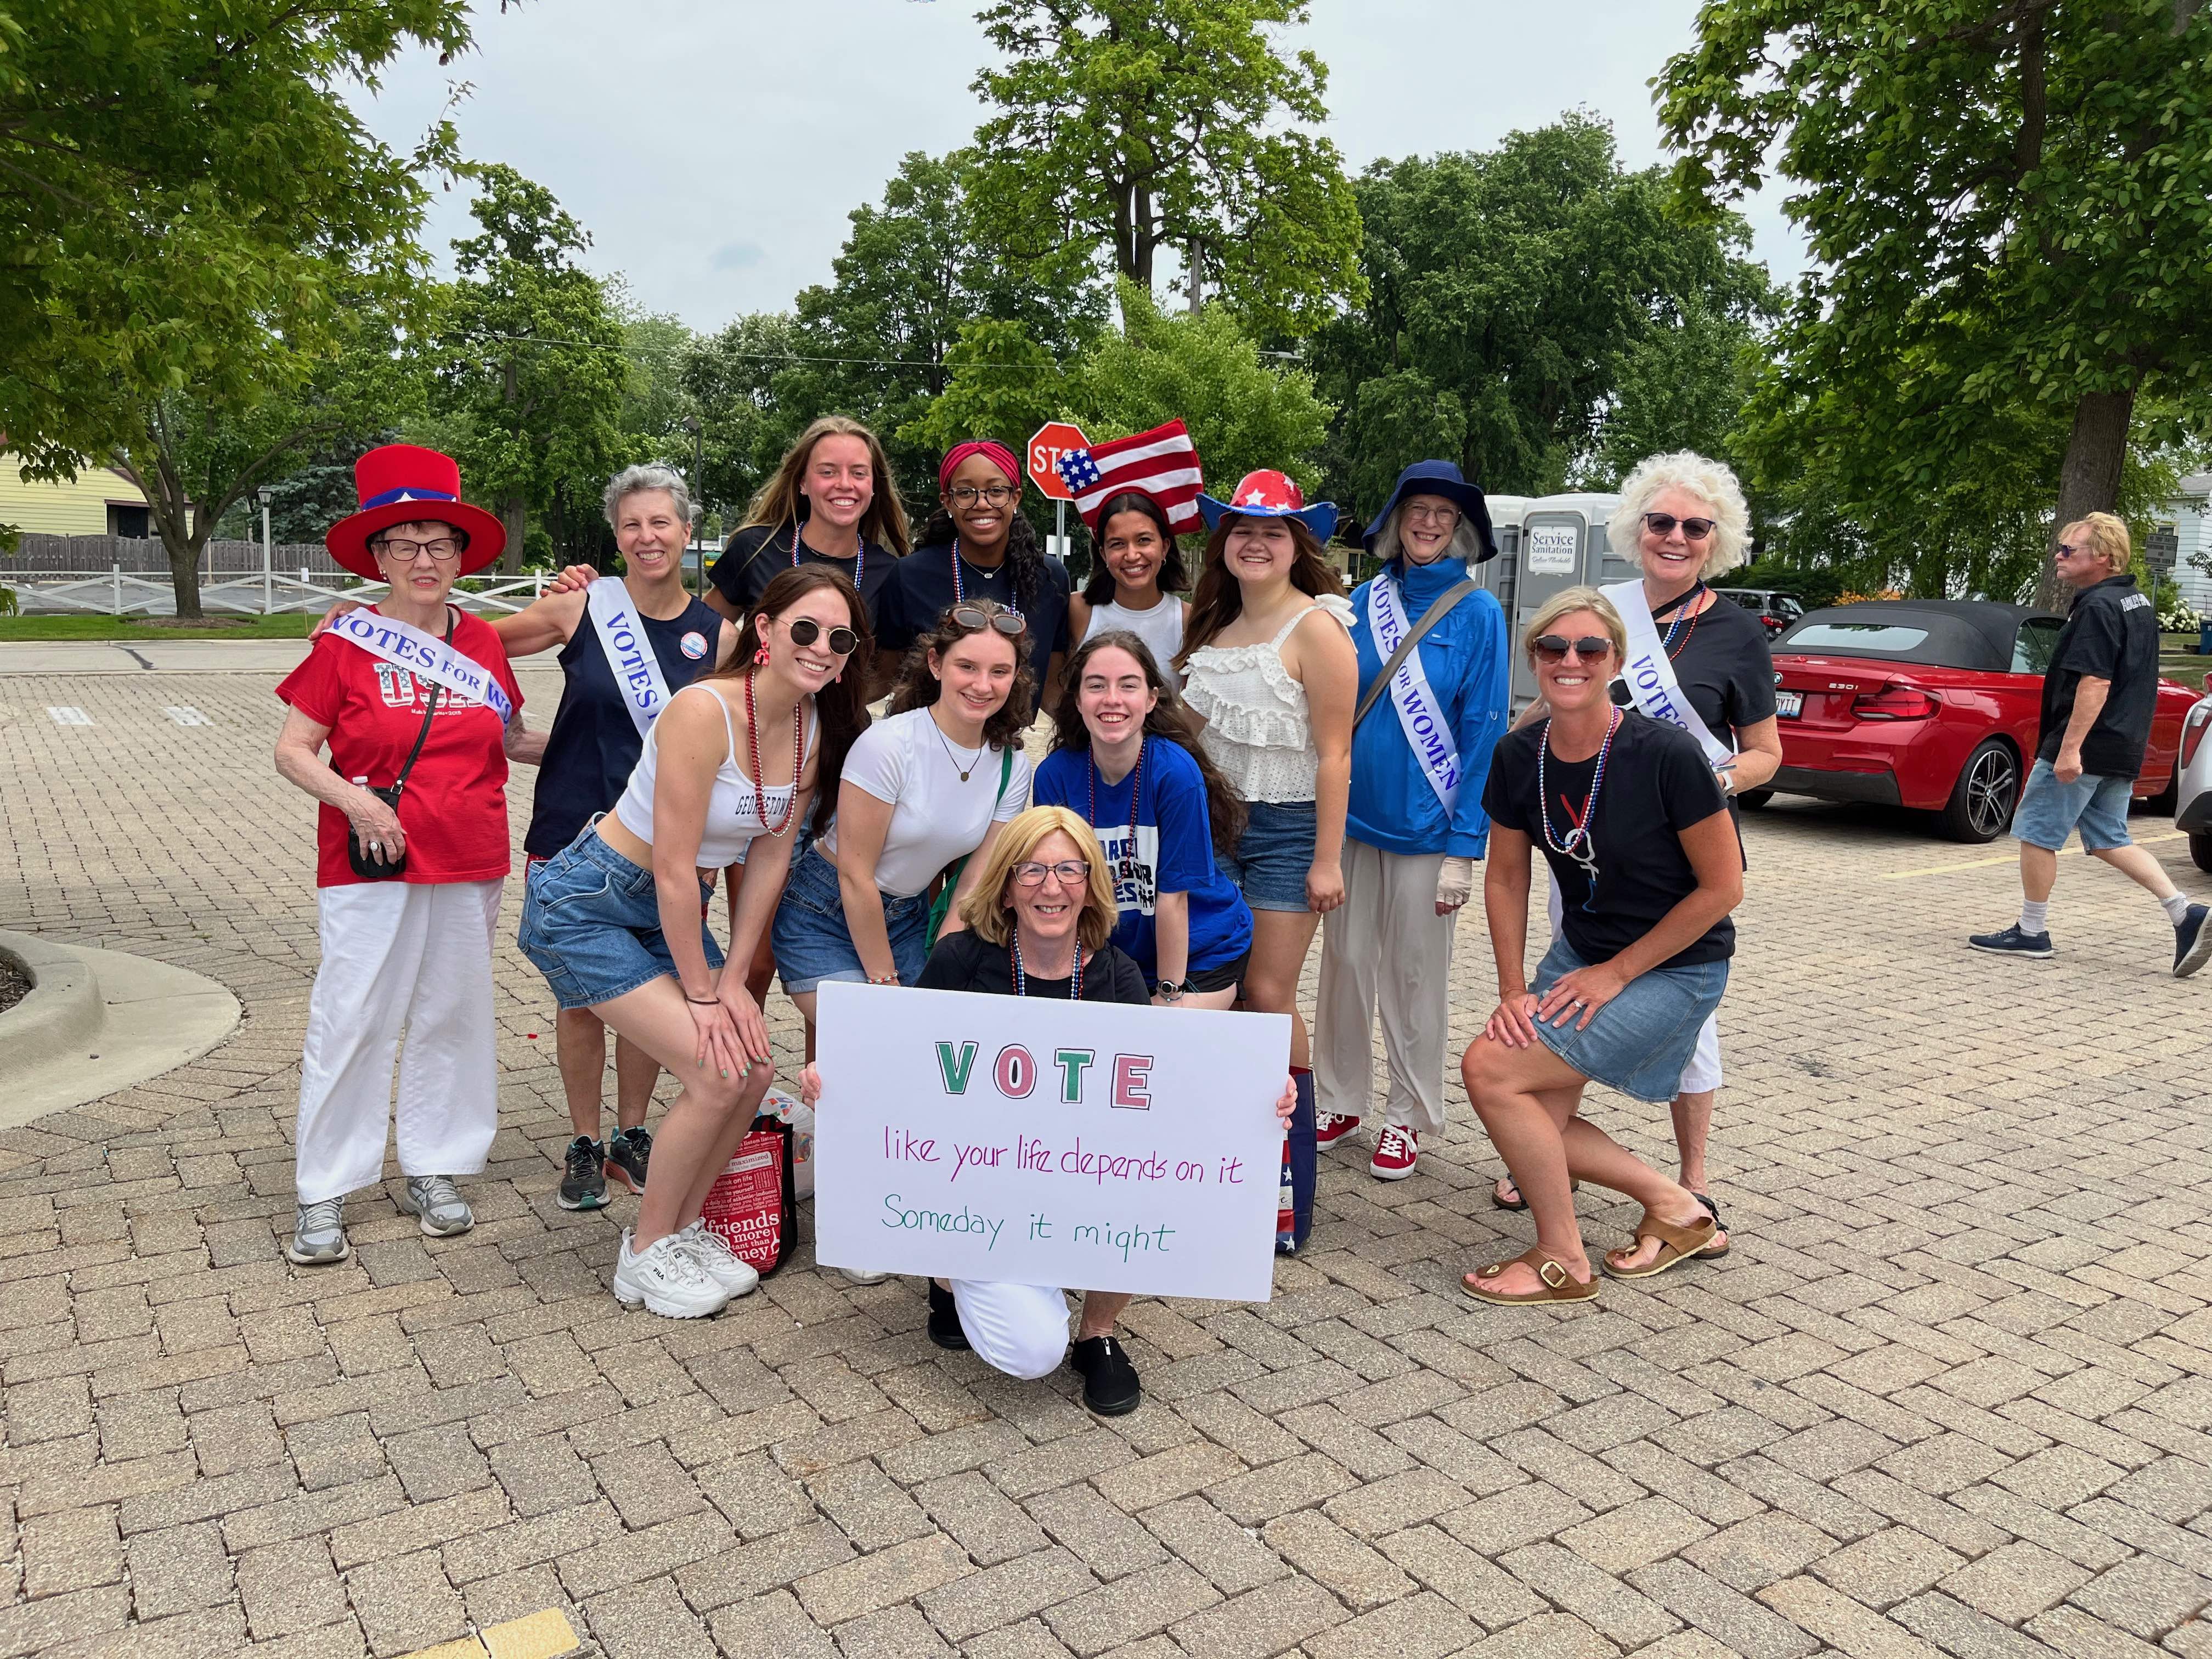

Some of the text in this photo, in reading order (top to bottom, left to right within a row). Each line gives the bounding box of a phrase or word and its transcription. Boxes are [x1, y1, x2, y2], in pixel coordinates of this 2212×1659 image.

[1033, 445, 1073, 475] ST
[1532, 545, 1572, 554] Sanitation
[1533, 532, 1573, 545] Service
[333, 614, 436, 668] VOTES
[441, 660, 480, 690] FOR
[606, 611, 658, 708] VOTES
[1403, 689, 1461, 791] WOMEN
[935, 1040, 1154, 1111] VOTE
[732, 1153, 769, 1167] maximized
[884, 1126, 1243, 1185] like your life depends on it
[732, 1185, 754, 1197] yourself
[707, 1210, 780, 1235] friends
[882, 1194, 1176, 1263] Someday it might
[733, 1228, 771, 1243] more
[751, 1239, 770, 1247] than
[653, 1267, 664, 1280] FILA
